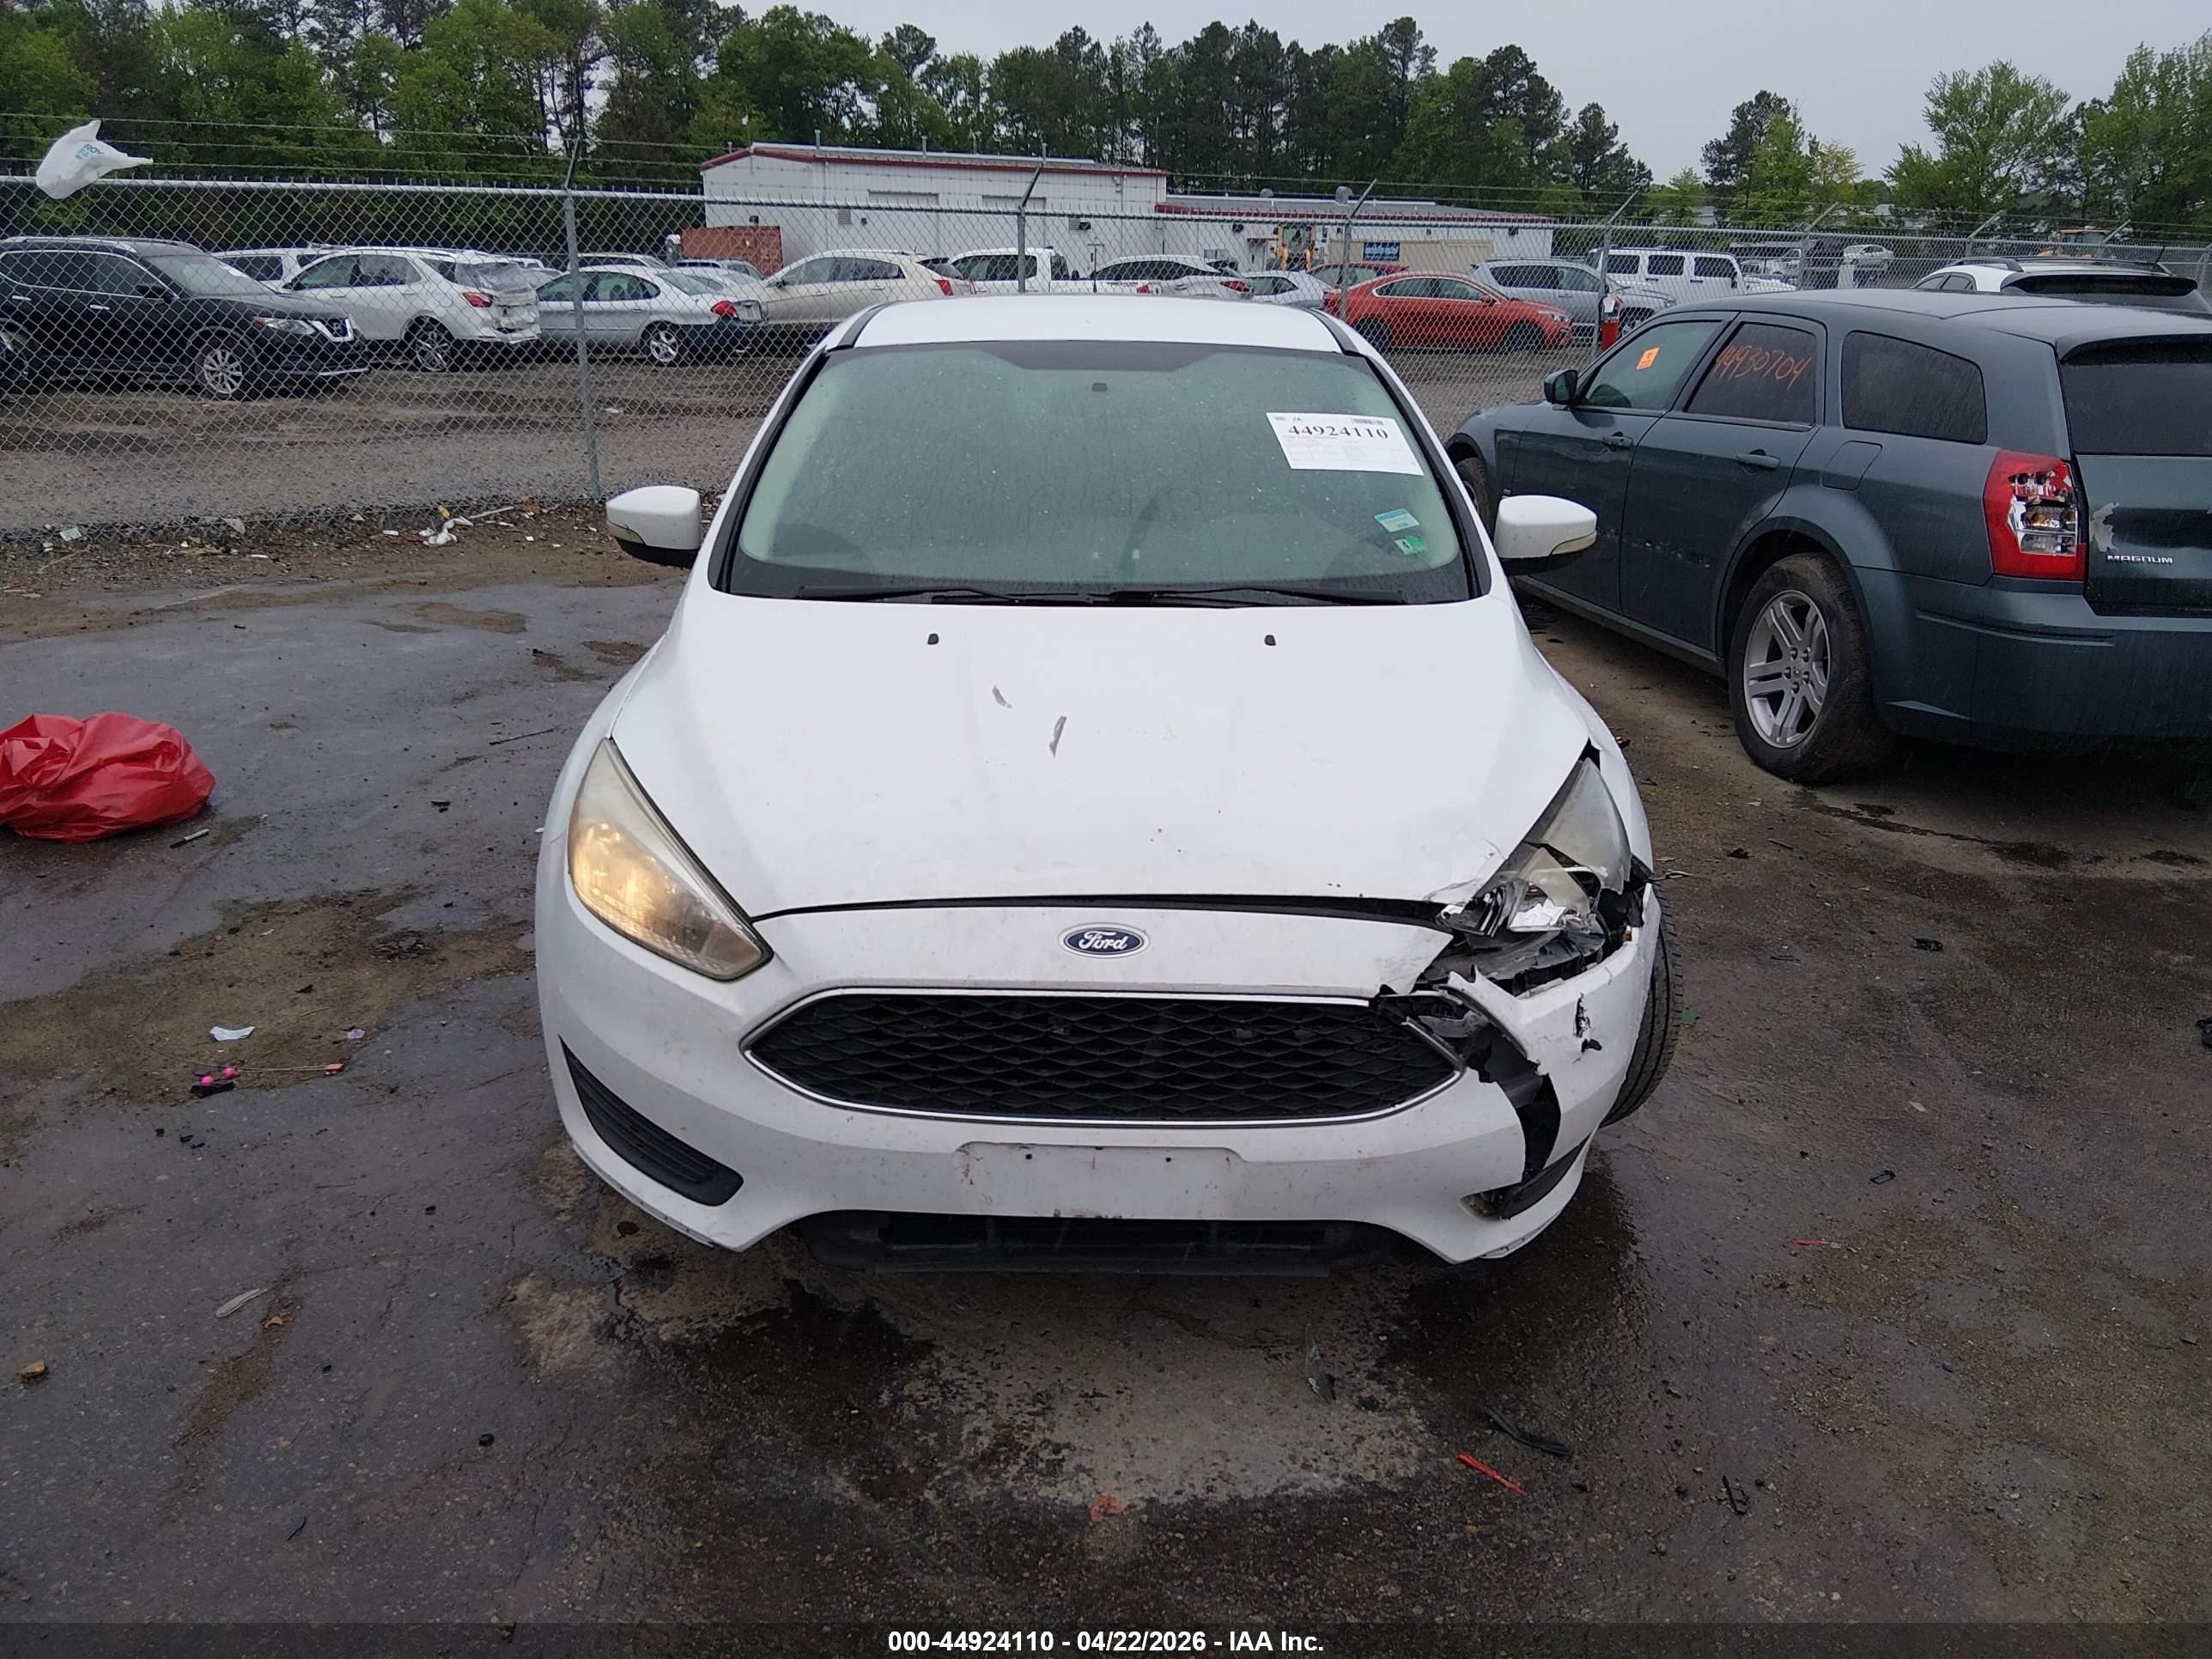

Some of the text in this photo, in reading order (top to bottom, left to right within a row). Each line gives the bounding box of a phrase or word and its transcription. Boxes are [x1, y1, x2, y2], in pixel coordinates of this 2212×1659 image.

[1288, 425, 1389, 440] 44924110
[2107, 555, 2173, 564] MAGNUM
[1079, 930, 1128, 950] Ford
